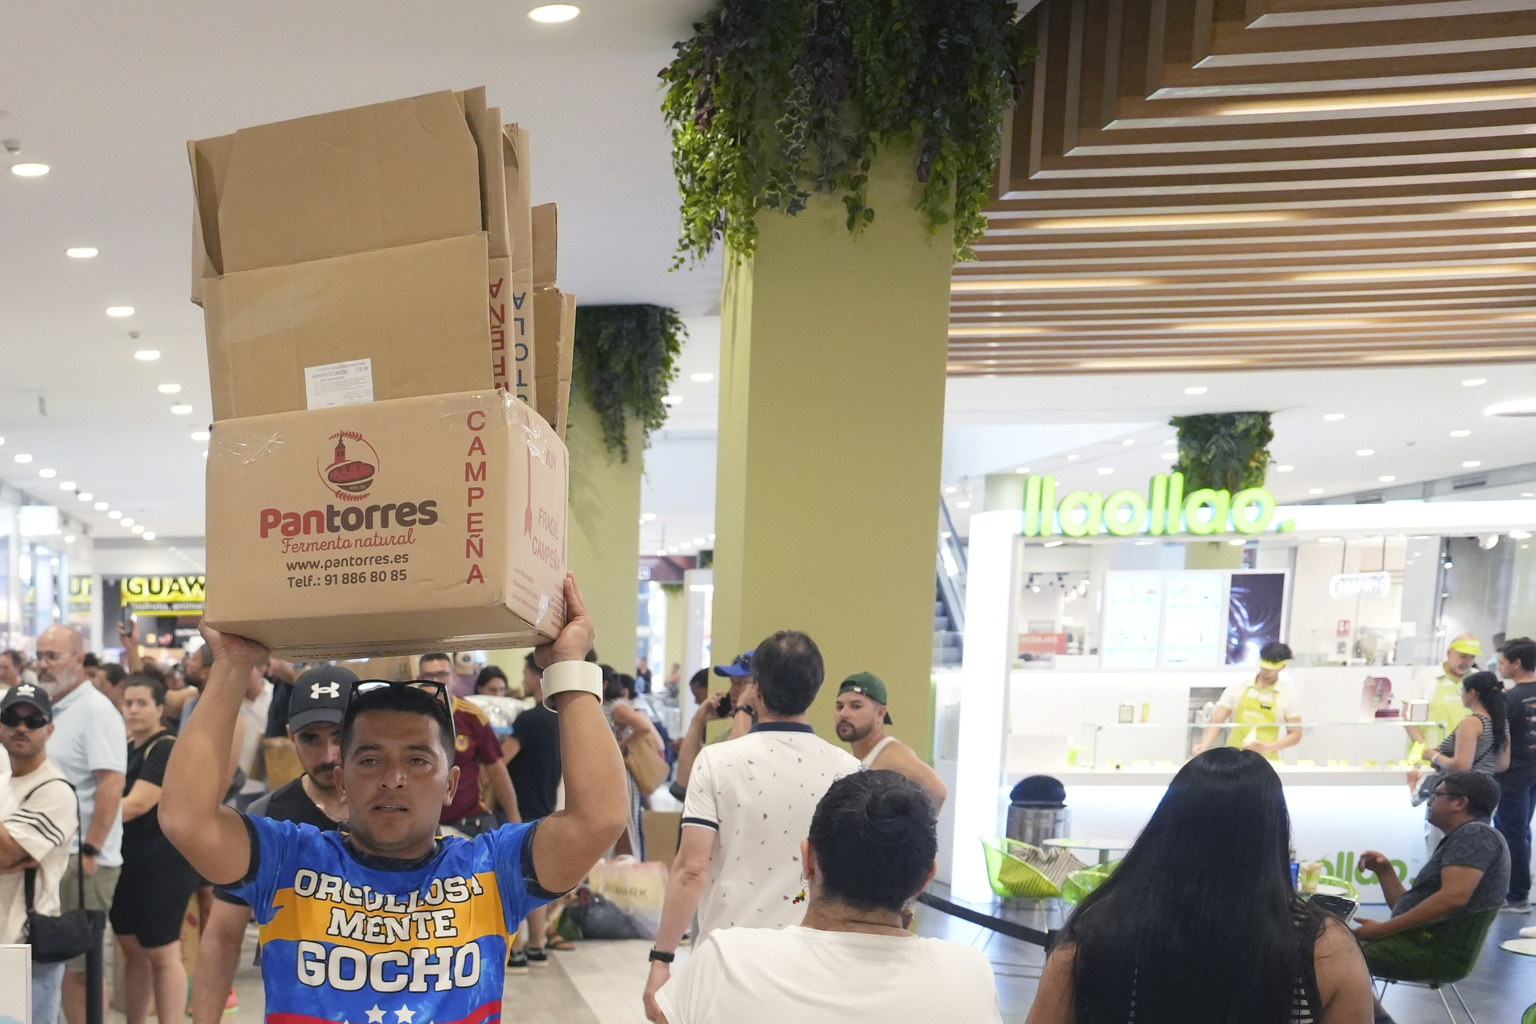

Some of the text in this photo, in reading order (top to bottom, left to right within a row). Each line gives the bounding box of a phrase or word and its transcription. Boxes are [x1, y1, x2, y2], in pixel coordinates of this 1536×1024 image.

[465, 410, 487, 585] CAMPEÑA
[260, 499, 438, 539] Pantorres
[281, 528, 415, 556] Fermento natural
[286, 552, 409, 573] www.pantorres.es
[287, 568, 407, 588] Telf.: 91 886 80 85
[326, 907, 457, 944] MENTE
[297, 940, 480, 992] GOCHO
